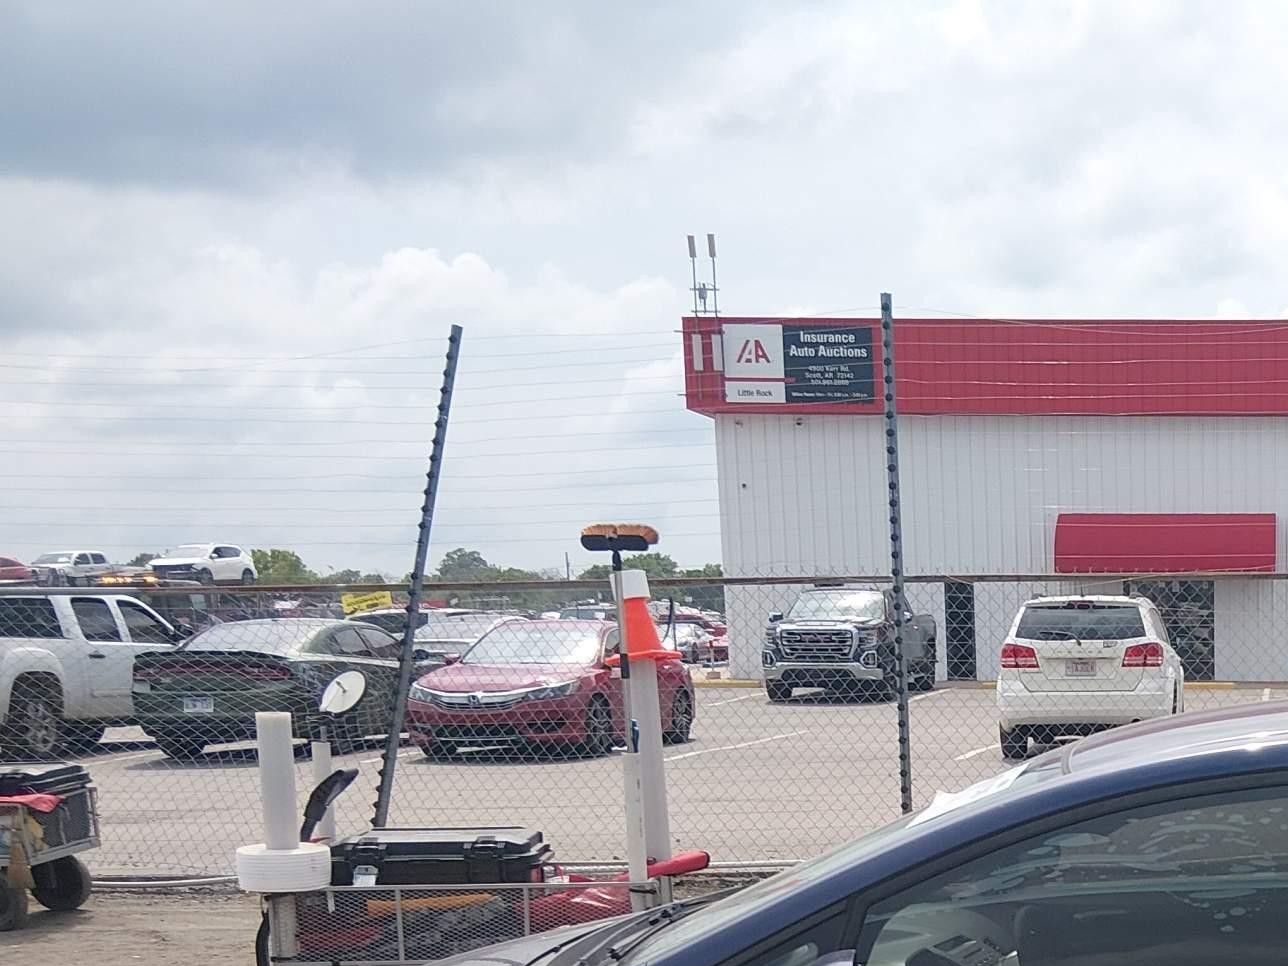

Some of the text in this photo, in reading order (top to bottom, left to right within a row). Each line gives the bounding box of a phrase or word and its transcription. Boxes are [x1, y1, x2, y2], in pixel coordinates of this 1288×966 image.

[799, 331, 856, 343] Insurance
[789, 345, 868, 357] Auto Auctions
[737, 389, 773, 397] Little Rock
